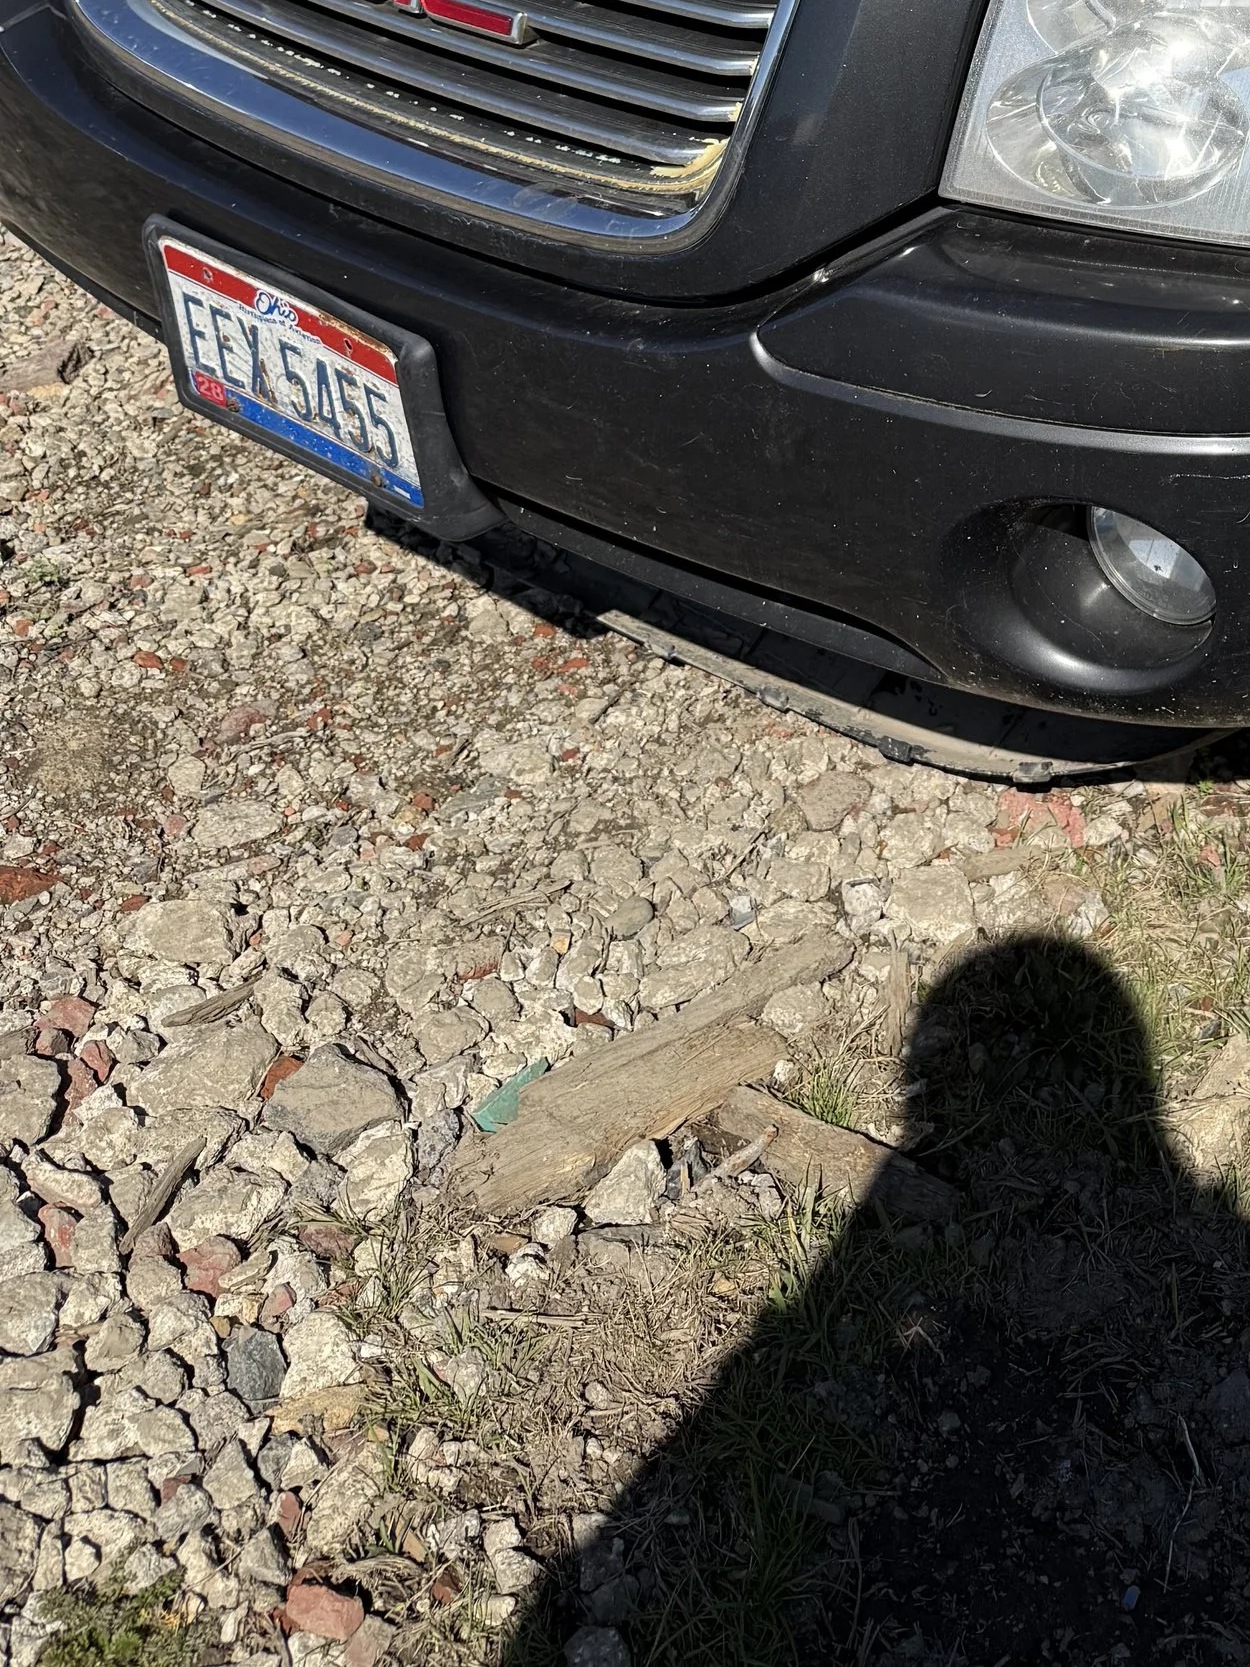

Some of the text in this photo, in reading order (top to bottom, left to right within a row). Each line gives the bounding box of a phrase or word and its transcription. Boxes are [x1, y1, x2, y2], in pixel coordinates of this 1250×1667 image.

[255, 291, 297, 322] Ohio
[182, 292, 399, 469] EEX 5455
[196, 375, 225, 402] 28
